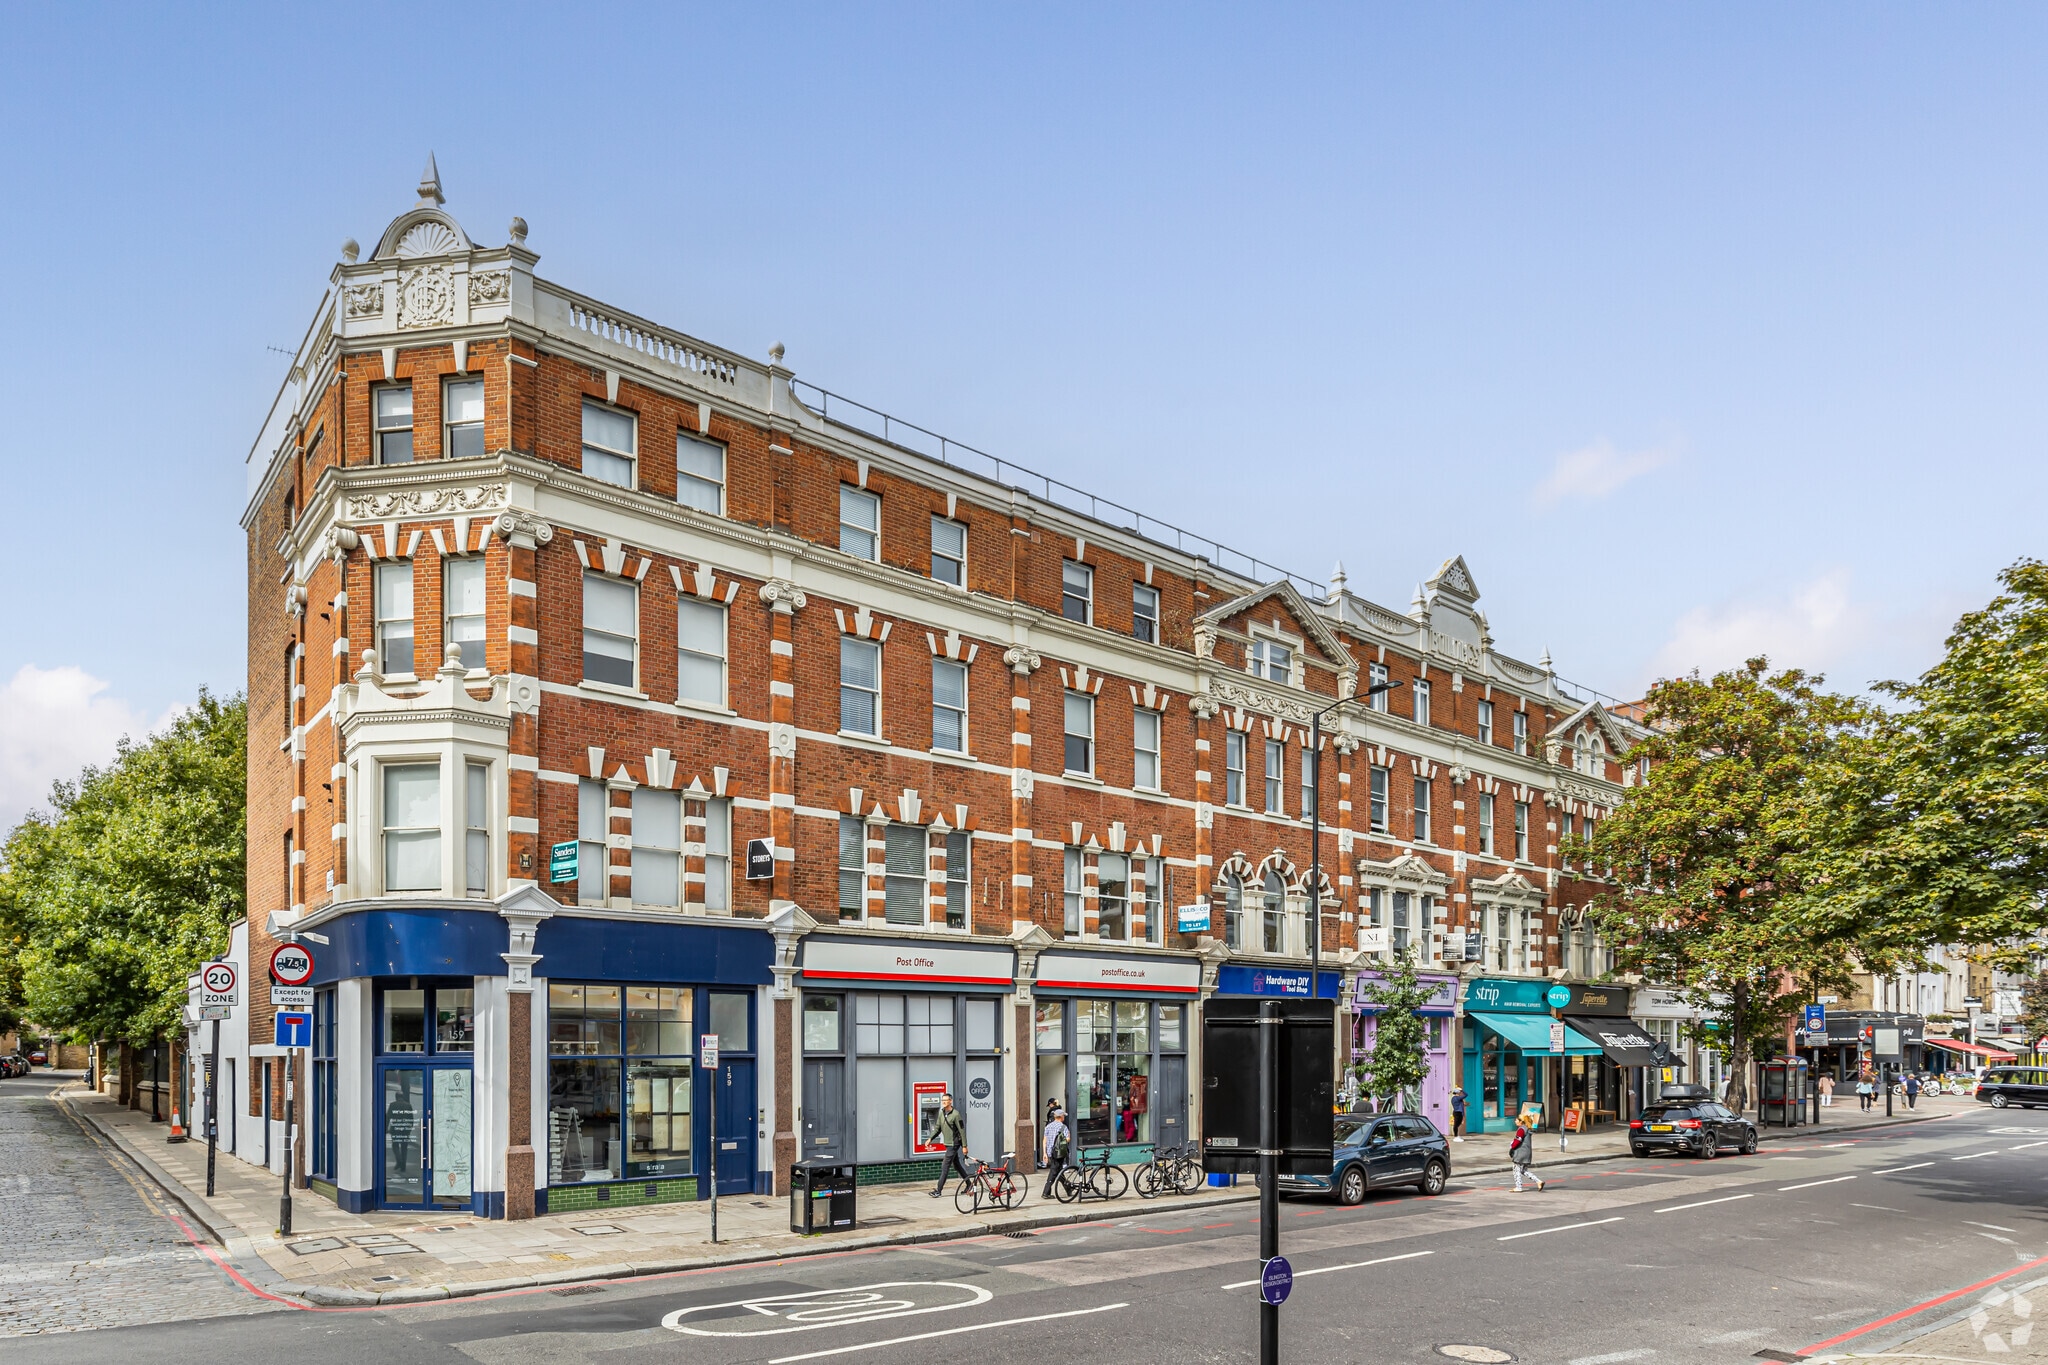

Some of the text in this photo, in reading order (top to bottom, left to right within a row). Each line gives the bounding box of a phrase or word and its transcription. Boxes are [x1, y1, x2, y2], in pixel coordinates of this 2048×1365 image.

[554, 847, 576, 857] Sanders
[752, 854, 771, 863] STOREYS
[896, 957, 934, 968] Post Office
[1101, 968, 1146, 978] postoffice.co.uk
[208, 972, 231, 985] 20
[1265, 974, 1309, 987] Hardware DIY
[274, 988, 312, 997] Except for
[1296, 986, 1308, 994] Shop
[204, 994, 234, 1003] ZONE
[448, 1030, 465, 1040] 159
[969, 1101, 992, 1110] Money
[1268, 1273, 1287, 1281] ISLINGTON
